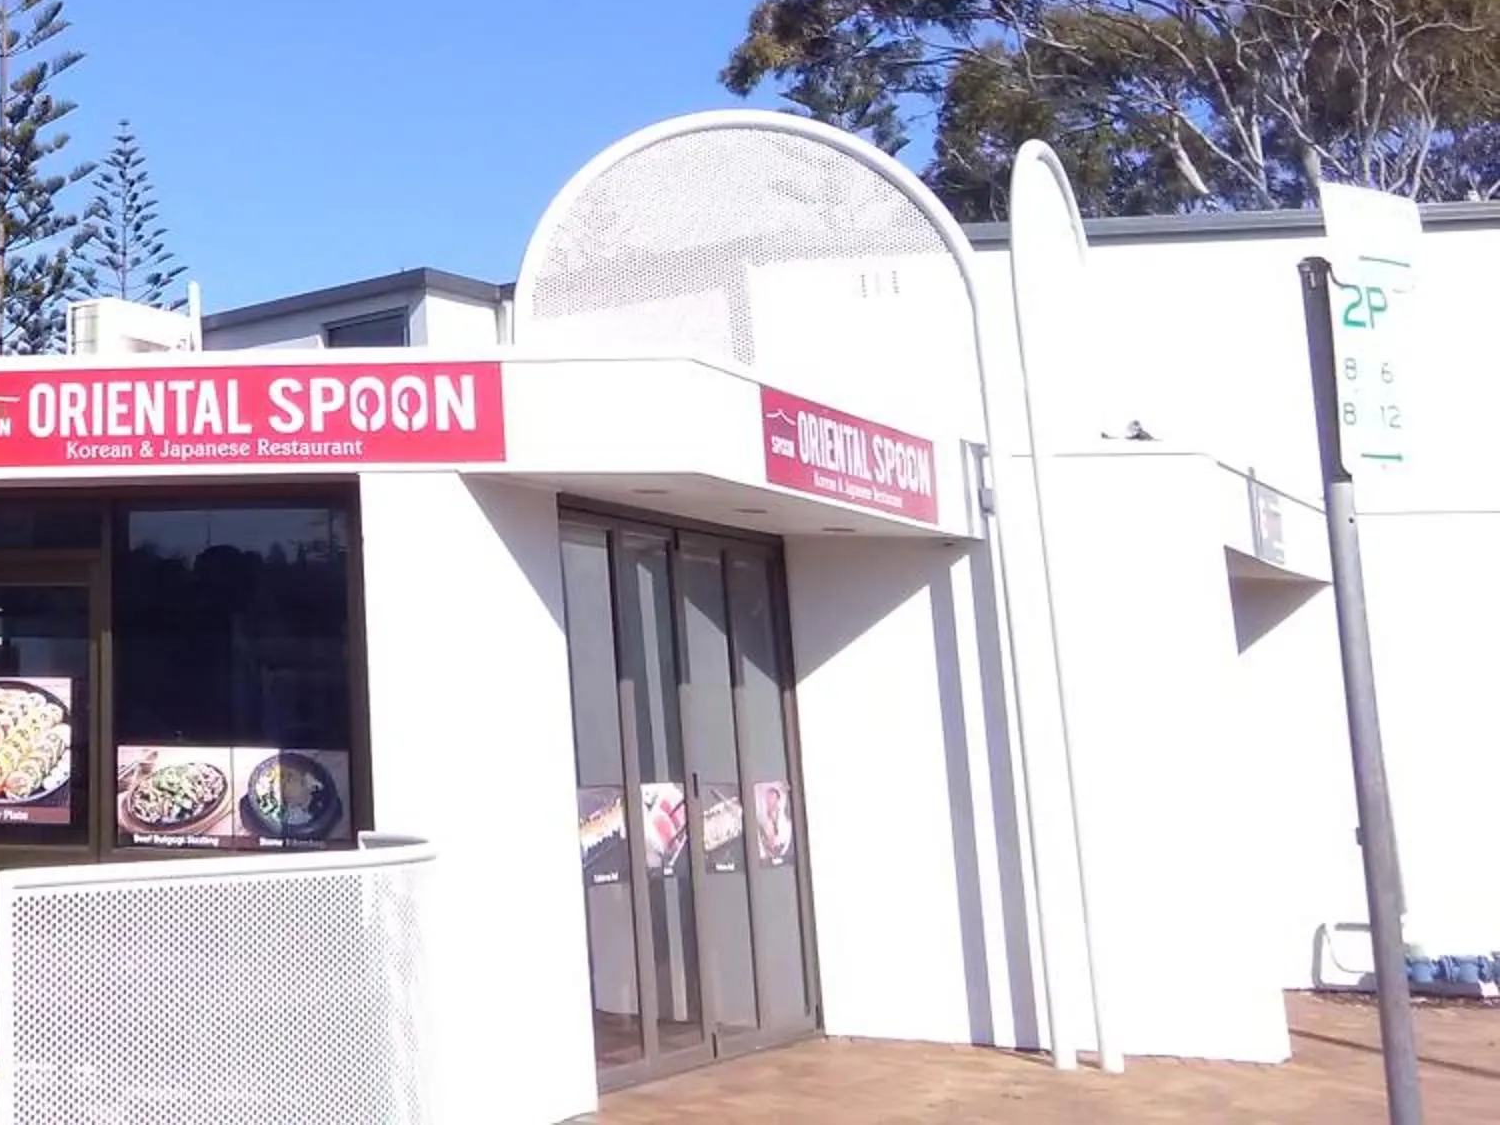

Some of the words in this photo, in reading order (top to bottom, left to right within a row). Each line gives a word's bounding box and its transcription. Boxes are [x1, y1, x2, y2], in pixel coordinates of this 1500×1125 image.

[1342, 283, 1388, 329] 2P
[28, 378, 252, 438] ORIENTAL
[268, 375, 478, 434] SPOON
[66, 441, 133, 459] Korean
[140, 441, 154, 457] &
[159, 439, 250, 461] Japanese
[257, 438, 363, 457] Restaurant
[797, 410, 872, 481] ORIENTAL
[872, 434, 932, 497] SPOON
[3, 808, 29, 820] Plate
